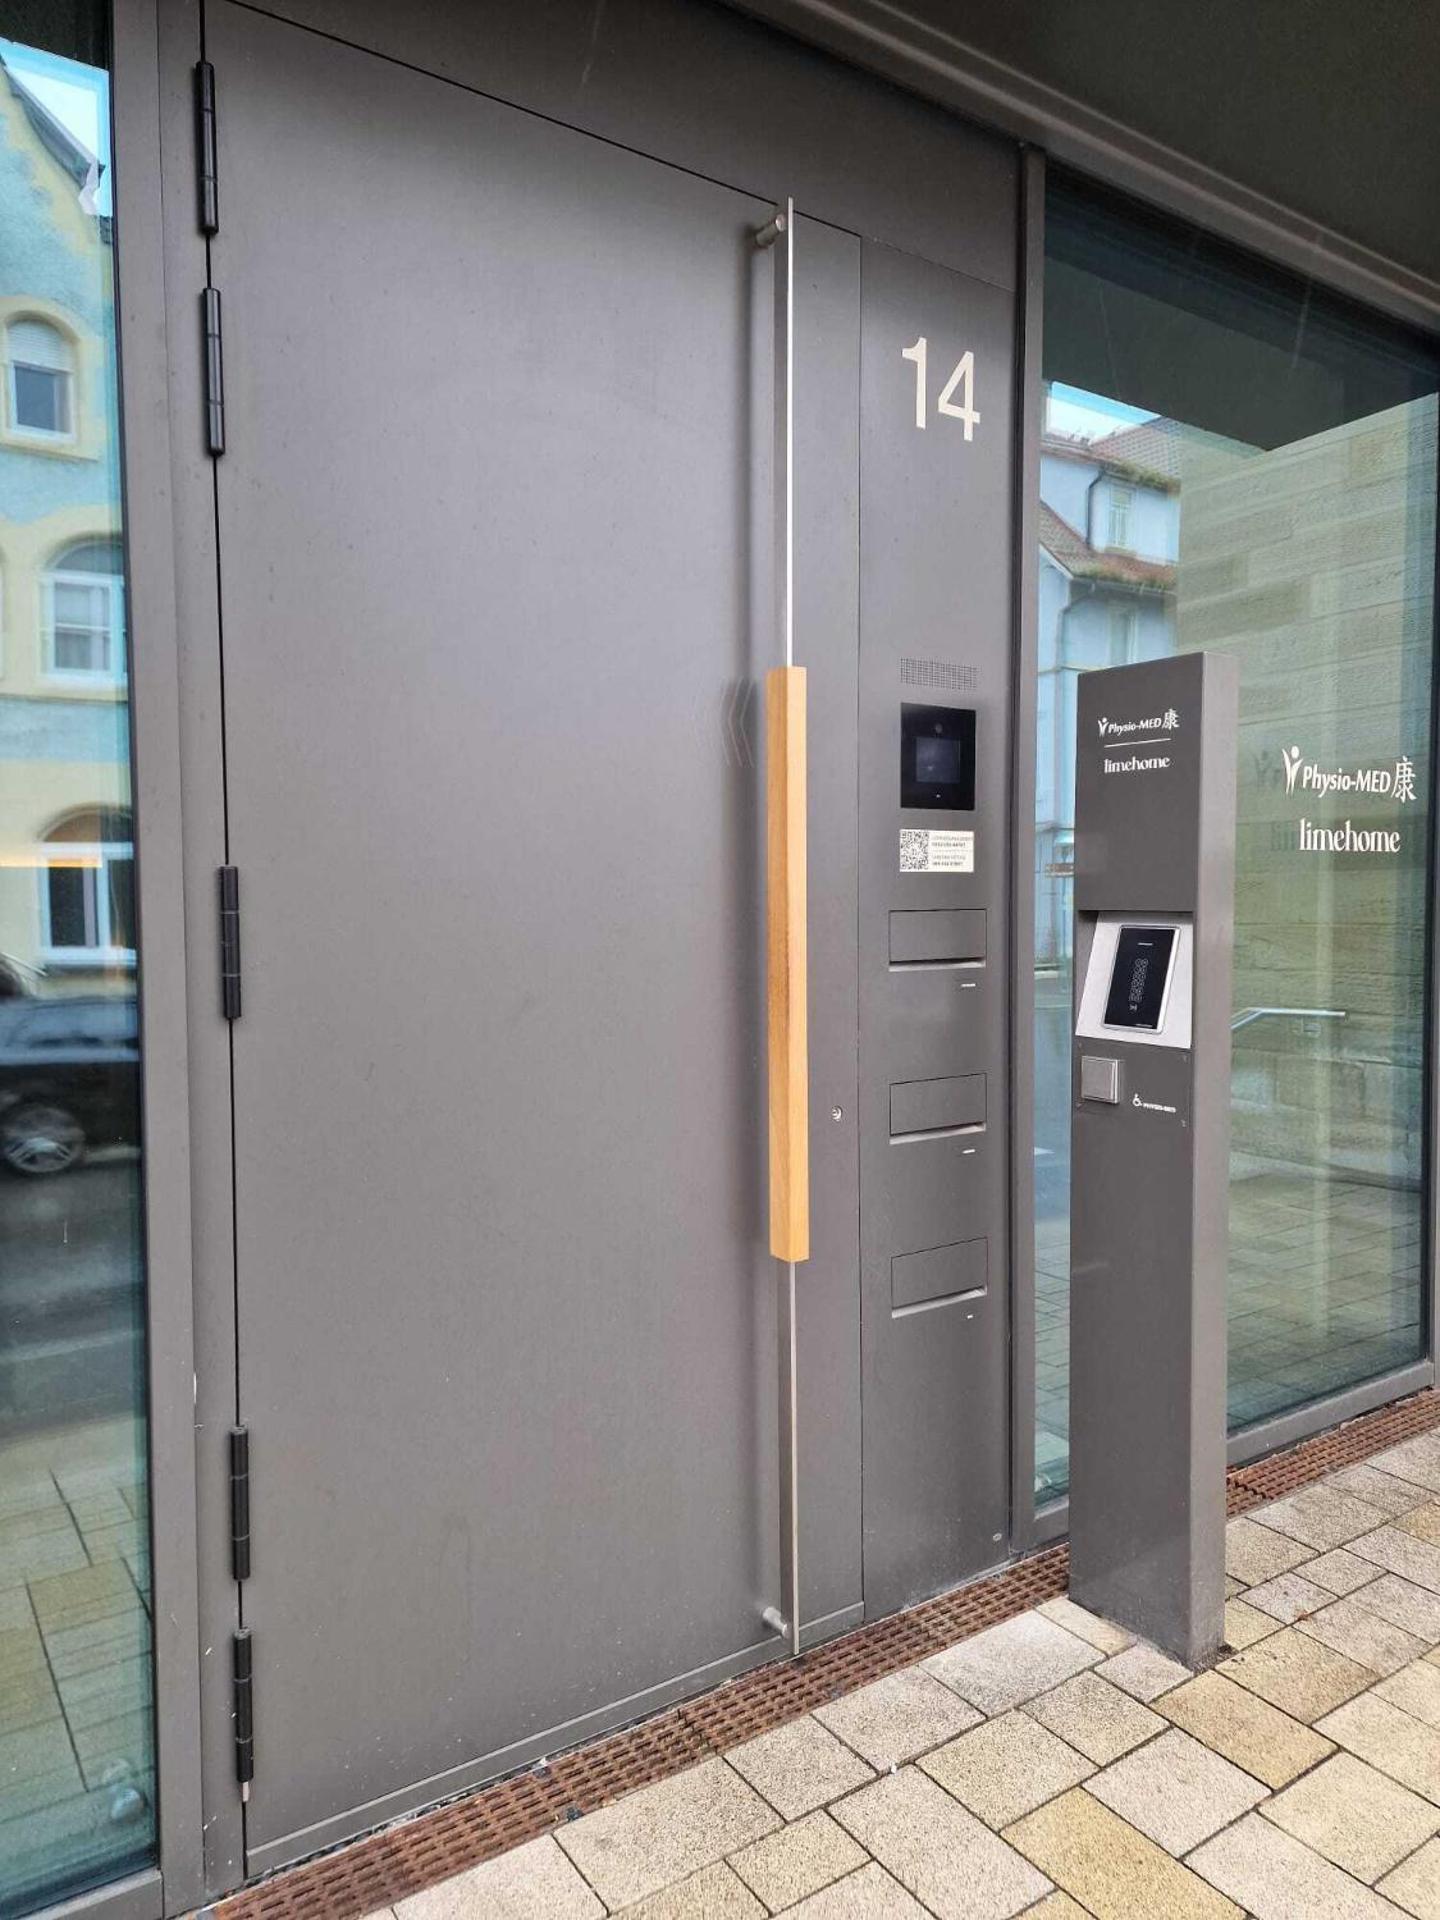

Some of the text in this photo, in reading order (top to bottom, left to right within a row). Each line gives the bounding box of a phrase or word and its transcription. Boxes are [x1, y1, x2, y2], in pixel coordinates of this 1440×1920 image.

[902, 337, 981, 441] 14
[1108, 717, 1162, 736] Physio-MED
[1104, 756, 1170, 774] limehome
[1302, 755, 1417, 803] Physio-MED 康
[1300, 818, 1401, 853] limehome
